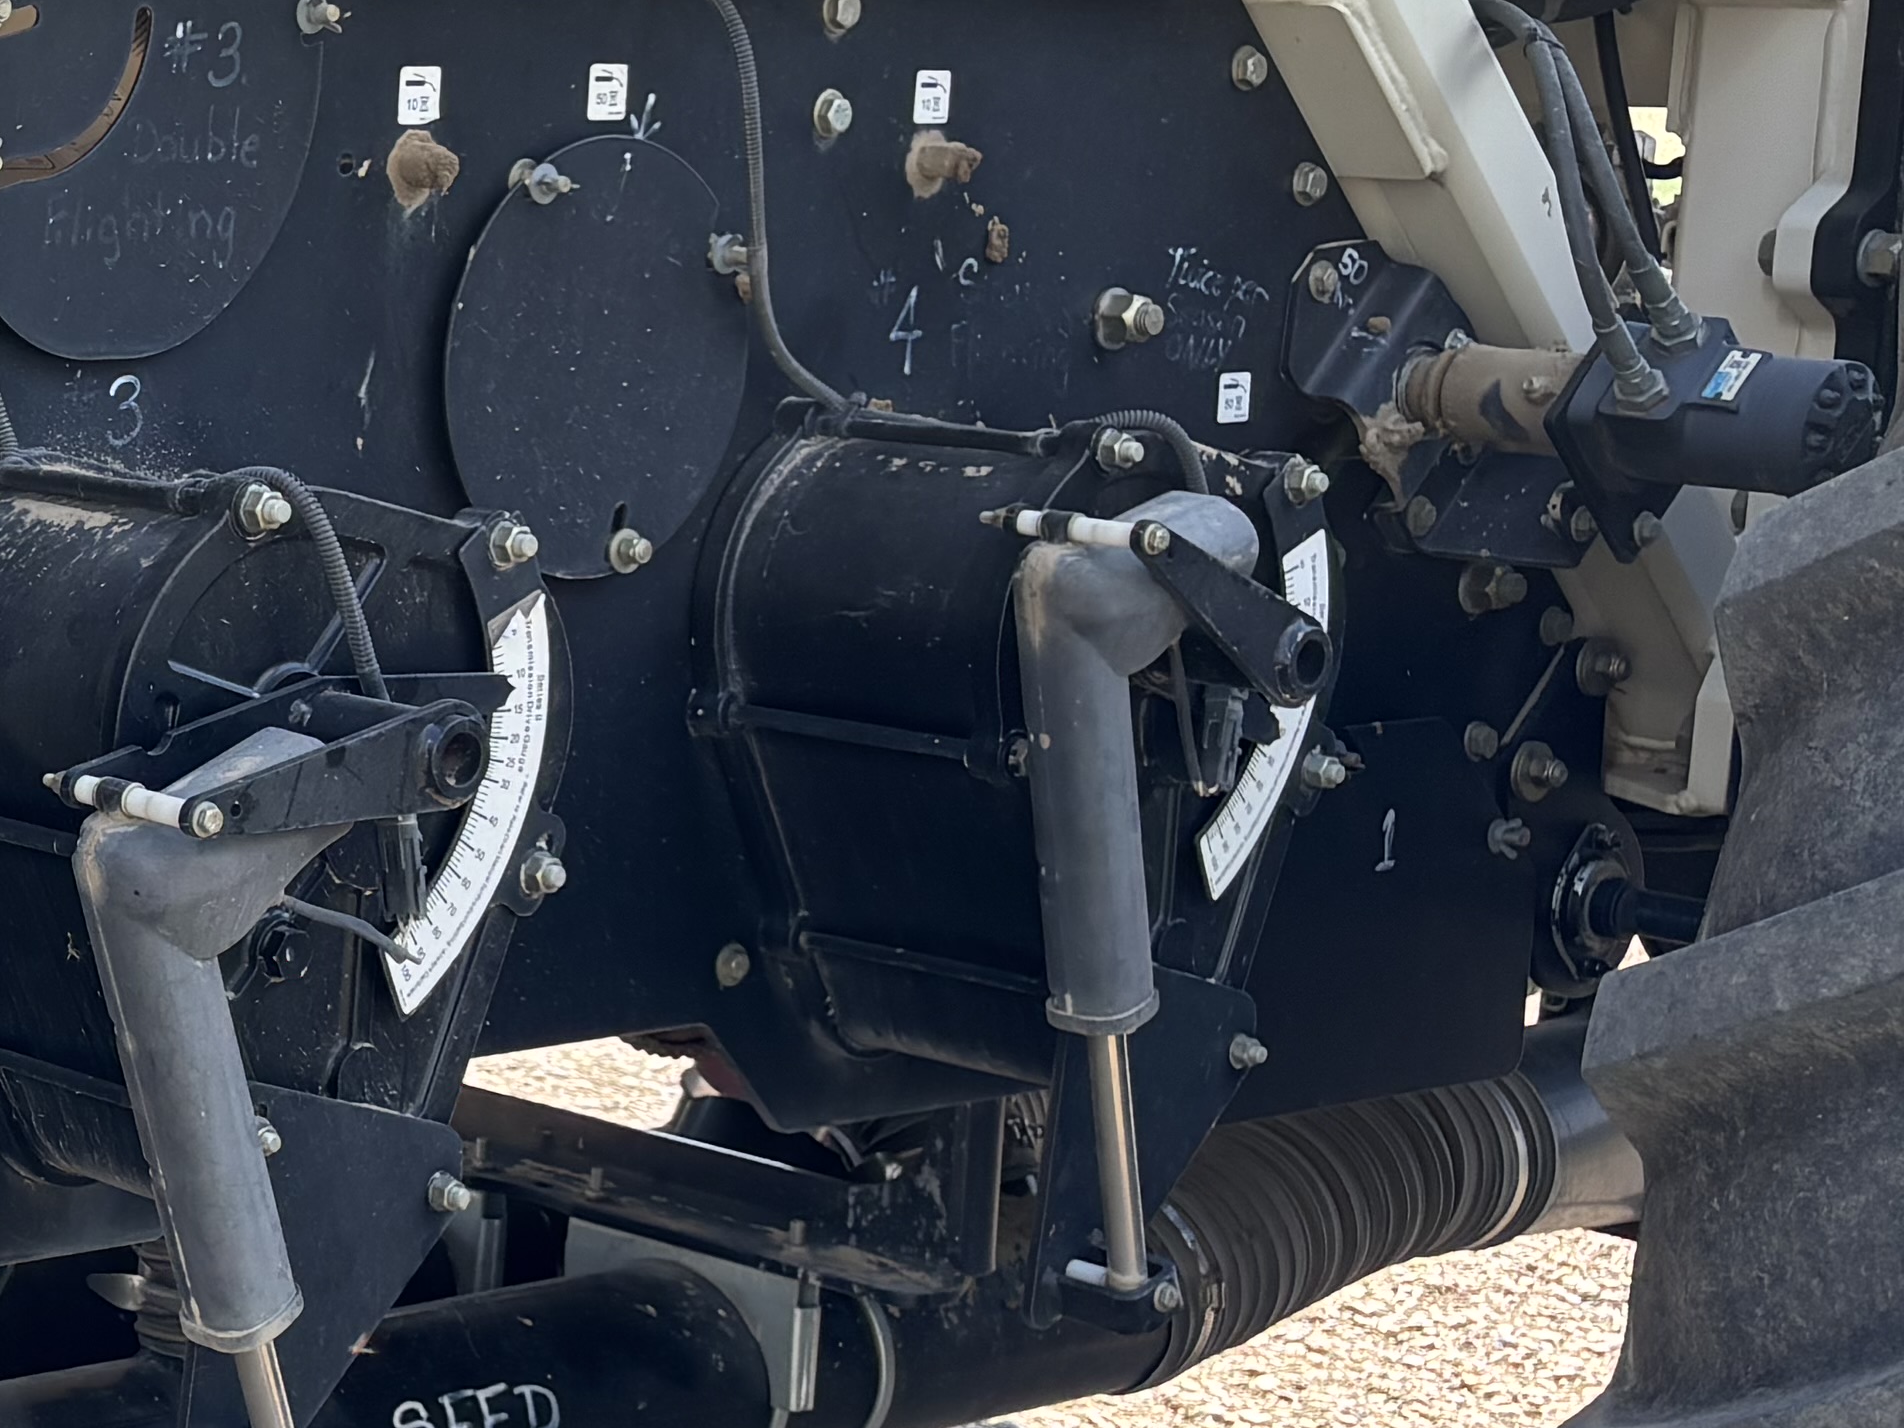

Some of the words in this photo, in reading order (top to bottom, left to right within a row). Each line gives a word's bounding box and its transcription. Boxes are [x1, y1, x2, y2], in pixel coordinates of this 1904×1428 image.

[407, 98, 418, 111] 10
[596, 93, 608, 106] 50
[128, 103, 260, 170] Double
[1338, 247, 1368, 285] 50
[1374, 808, 1396, 872] 1
[447, 902, 457, 916] 70
